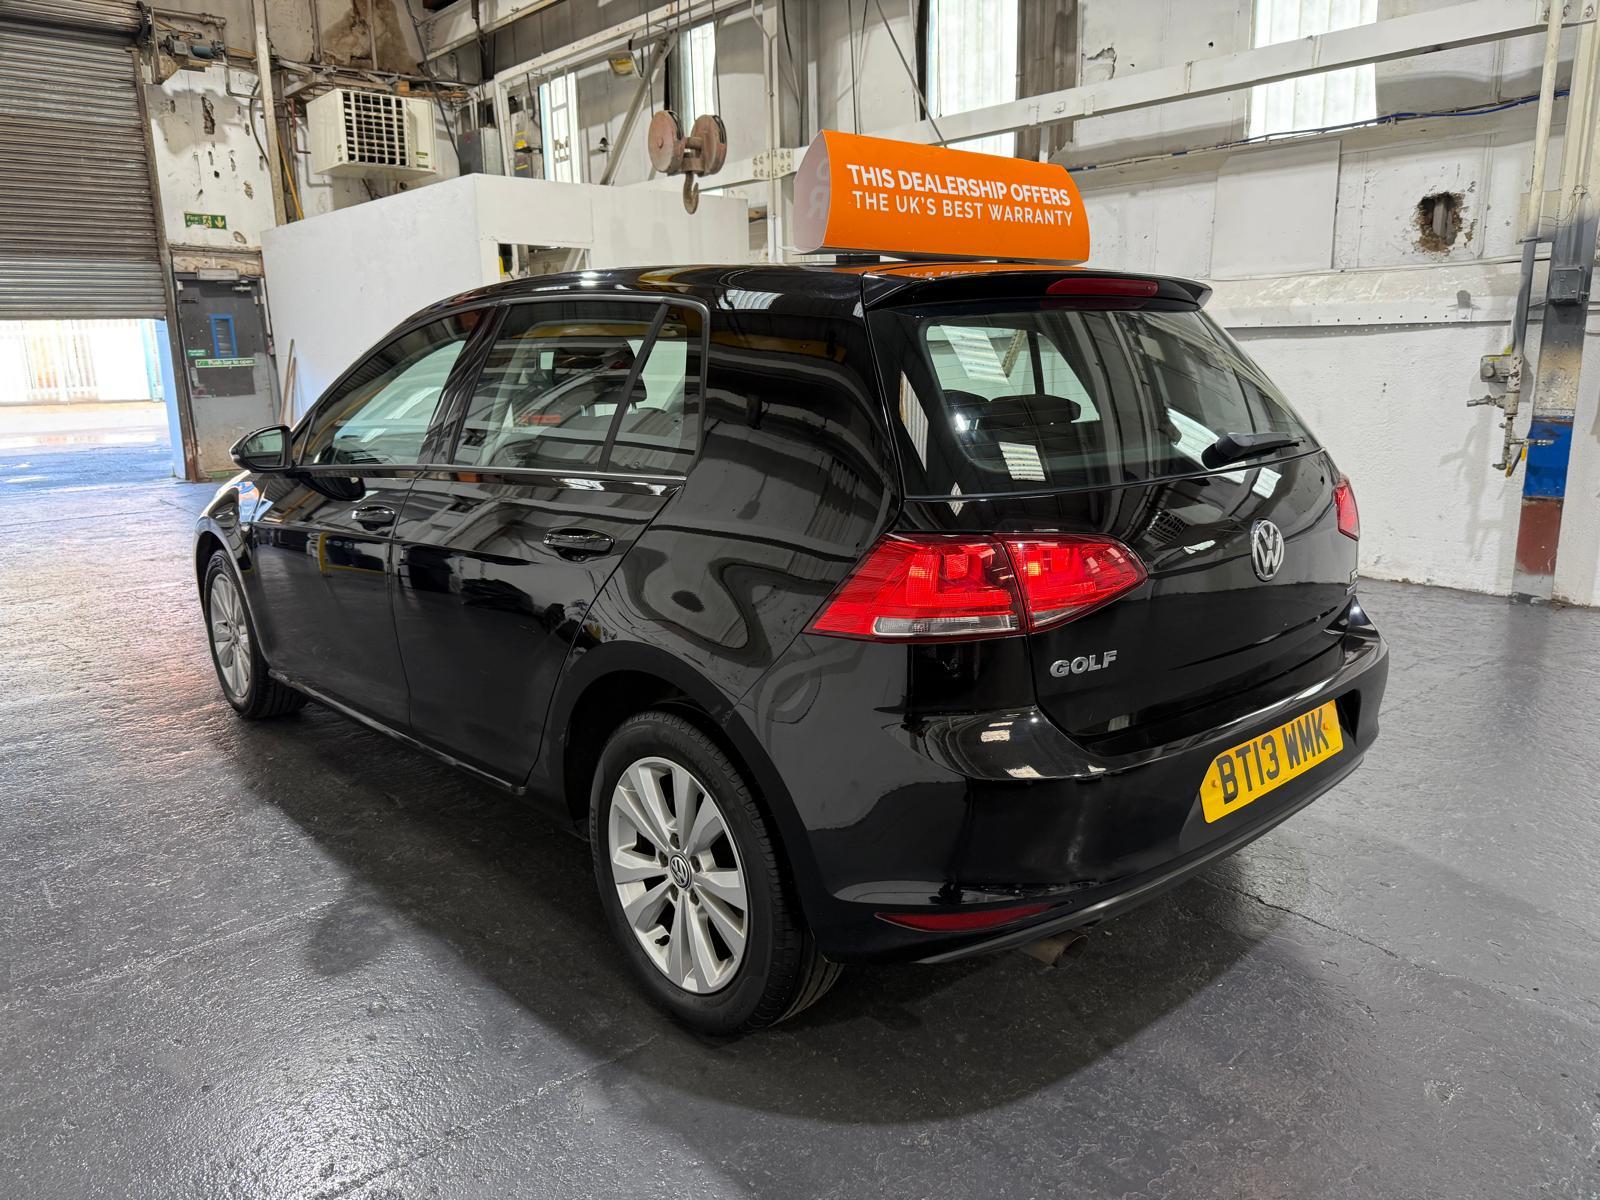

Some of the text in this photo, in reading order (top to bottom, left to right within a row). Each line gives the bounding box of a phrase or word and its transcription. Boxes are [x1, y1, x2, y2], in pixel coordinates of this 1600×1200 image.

[846, 164, 1071, 207] THIS DEALERSHIP OFFERS
[852, 190, 1072, 227] THE UK'S BEST WARRANTY
[1050, 650, 1118, 678] GOLF
[1216, 708, 1330, 805] BT13 WMK
